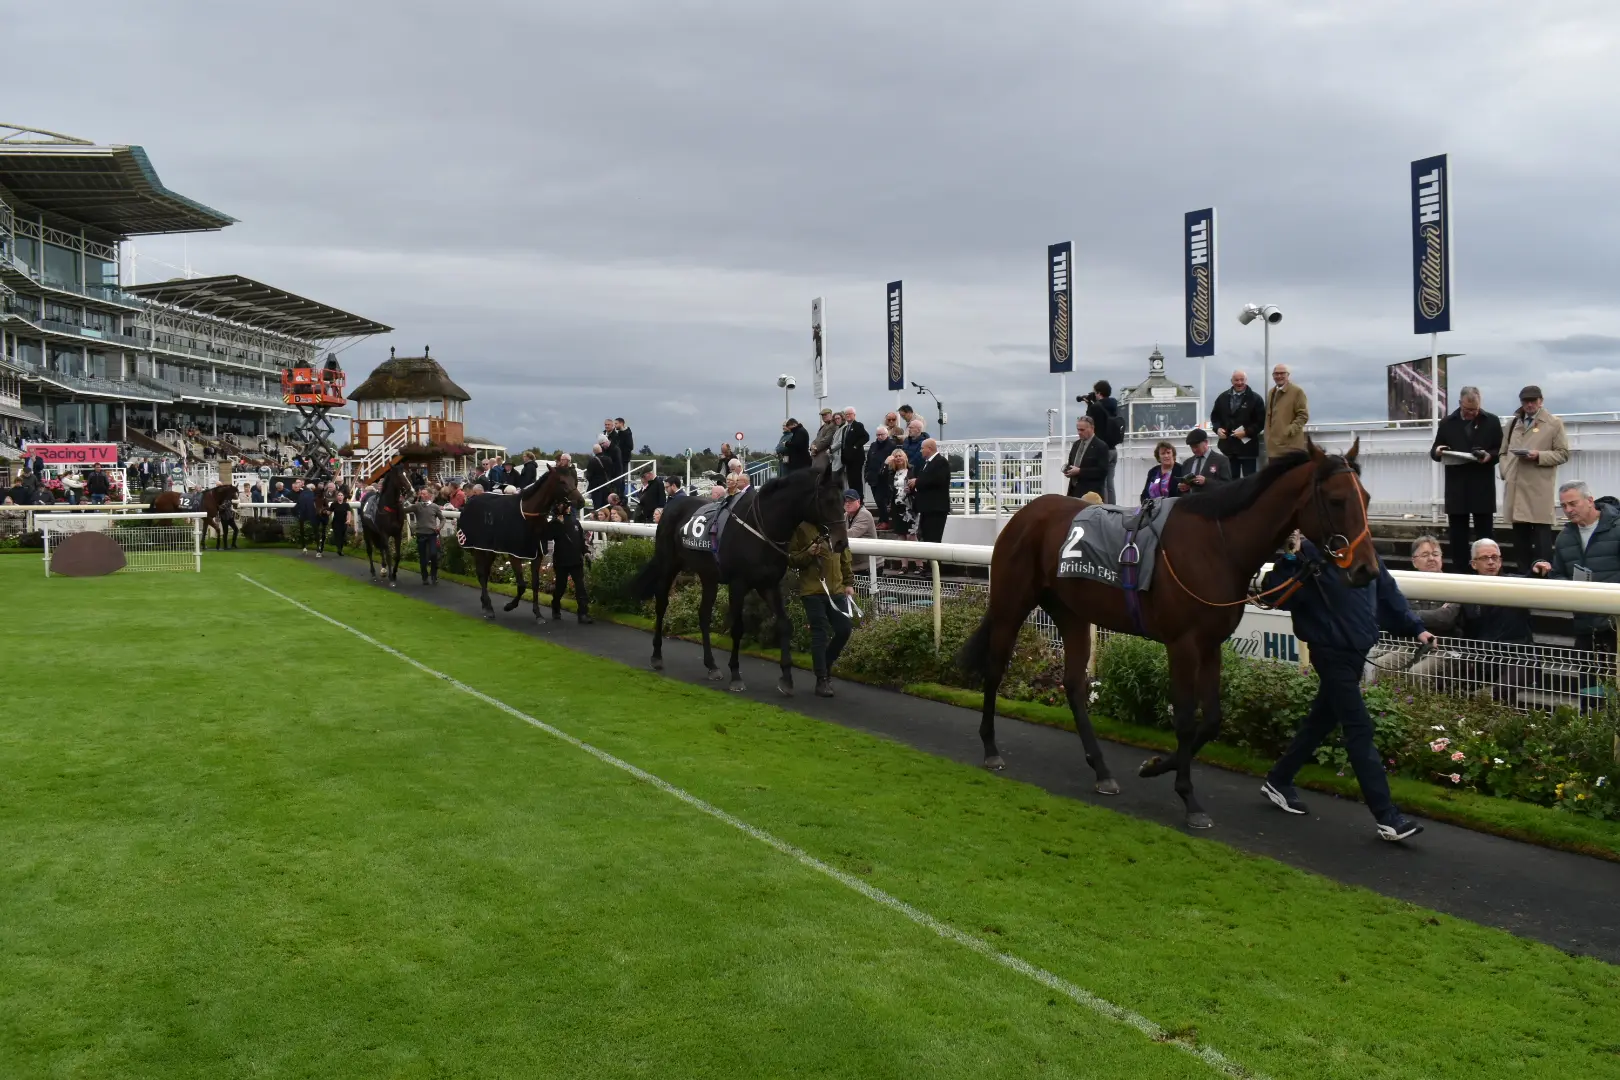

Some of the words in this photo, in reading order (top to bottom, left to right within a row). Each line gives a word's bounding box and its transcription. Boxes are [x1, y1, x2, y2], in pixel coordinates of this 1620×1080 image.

[1419, 168, 1440, 223] HILL
[1191, 219, 1208, 265] HILL
[1053, 251, 1067, 291] HILL
[1418, 223, 1443, 319] William
[890, 289, 900, 322] HILL
[1190, 265, 1211, 345] William
[1053, 291, 1069, 362] William
[890, 322, 901, 382] William
[36, 447, 86, 461] Racing
[89, 447, 108, 459] TV
[180, 497, 190, 506] 12
[681, 515, 707, 538] 16
[1061, 526, 1085, 559] 2
[1060, 560, 1095, 575] British
[1264, 632, 1299, 662] HIL
